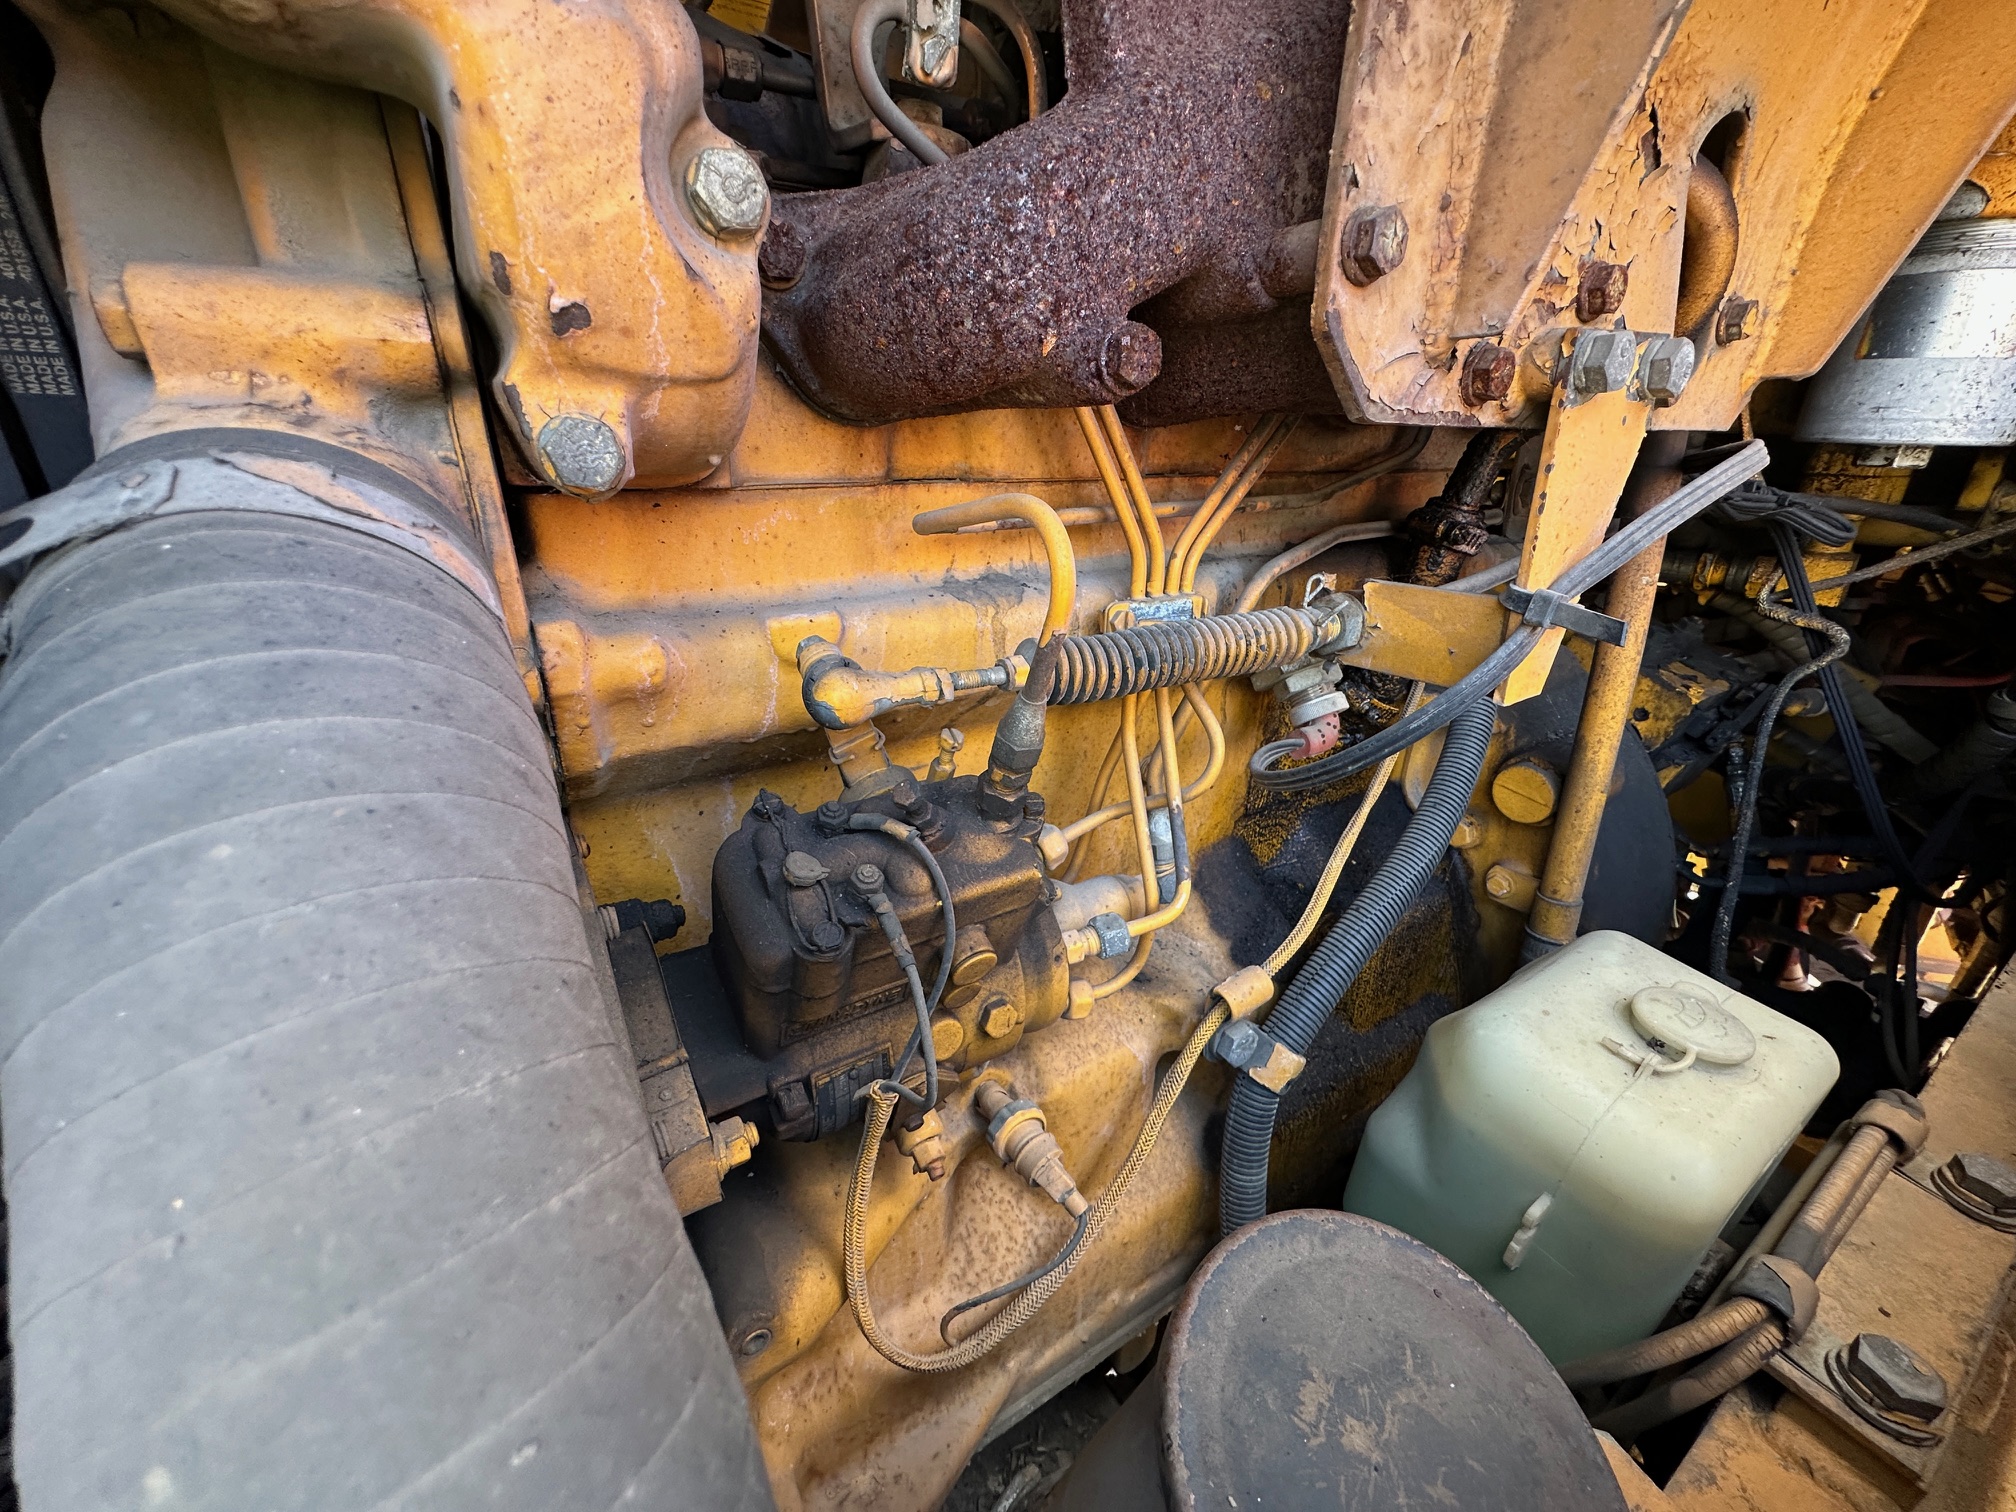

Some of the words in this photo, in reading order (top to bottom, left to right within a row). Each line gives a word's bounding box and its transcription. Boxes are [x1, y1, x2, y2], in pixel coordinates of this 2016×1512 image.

[0, 295, 20, 335] U.S.A.
[13, 296, 38, 336] U.S.A.
[30, 297, 54, 336] U.S.A.
[10, 337, 24, 351] IN
[26, 338, 44, 353] IN
[44, 339, 61, 354] IN
[2, 355, 26, 394] MADE
[16, 355, 43, 395] MADE
[33, 355, 60, 395] MADE
[49, 356, 76, 396] MADE
